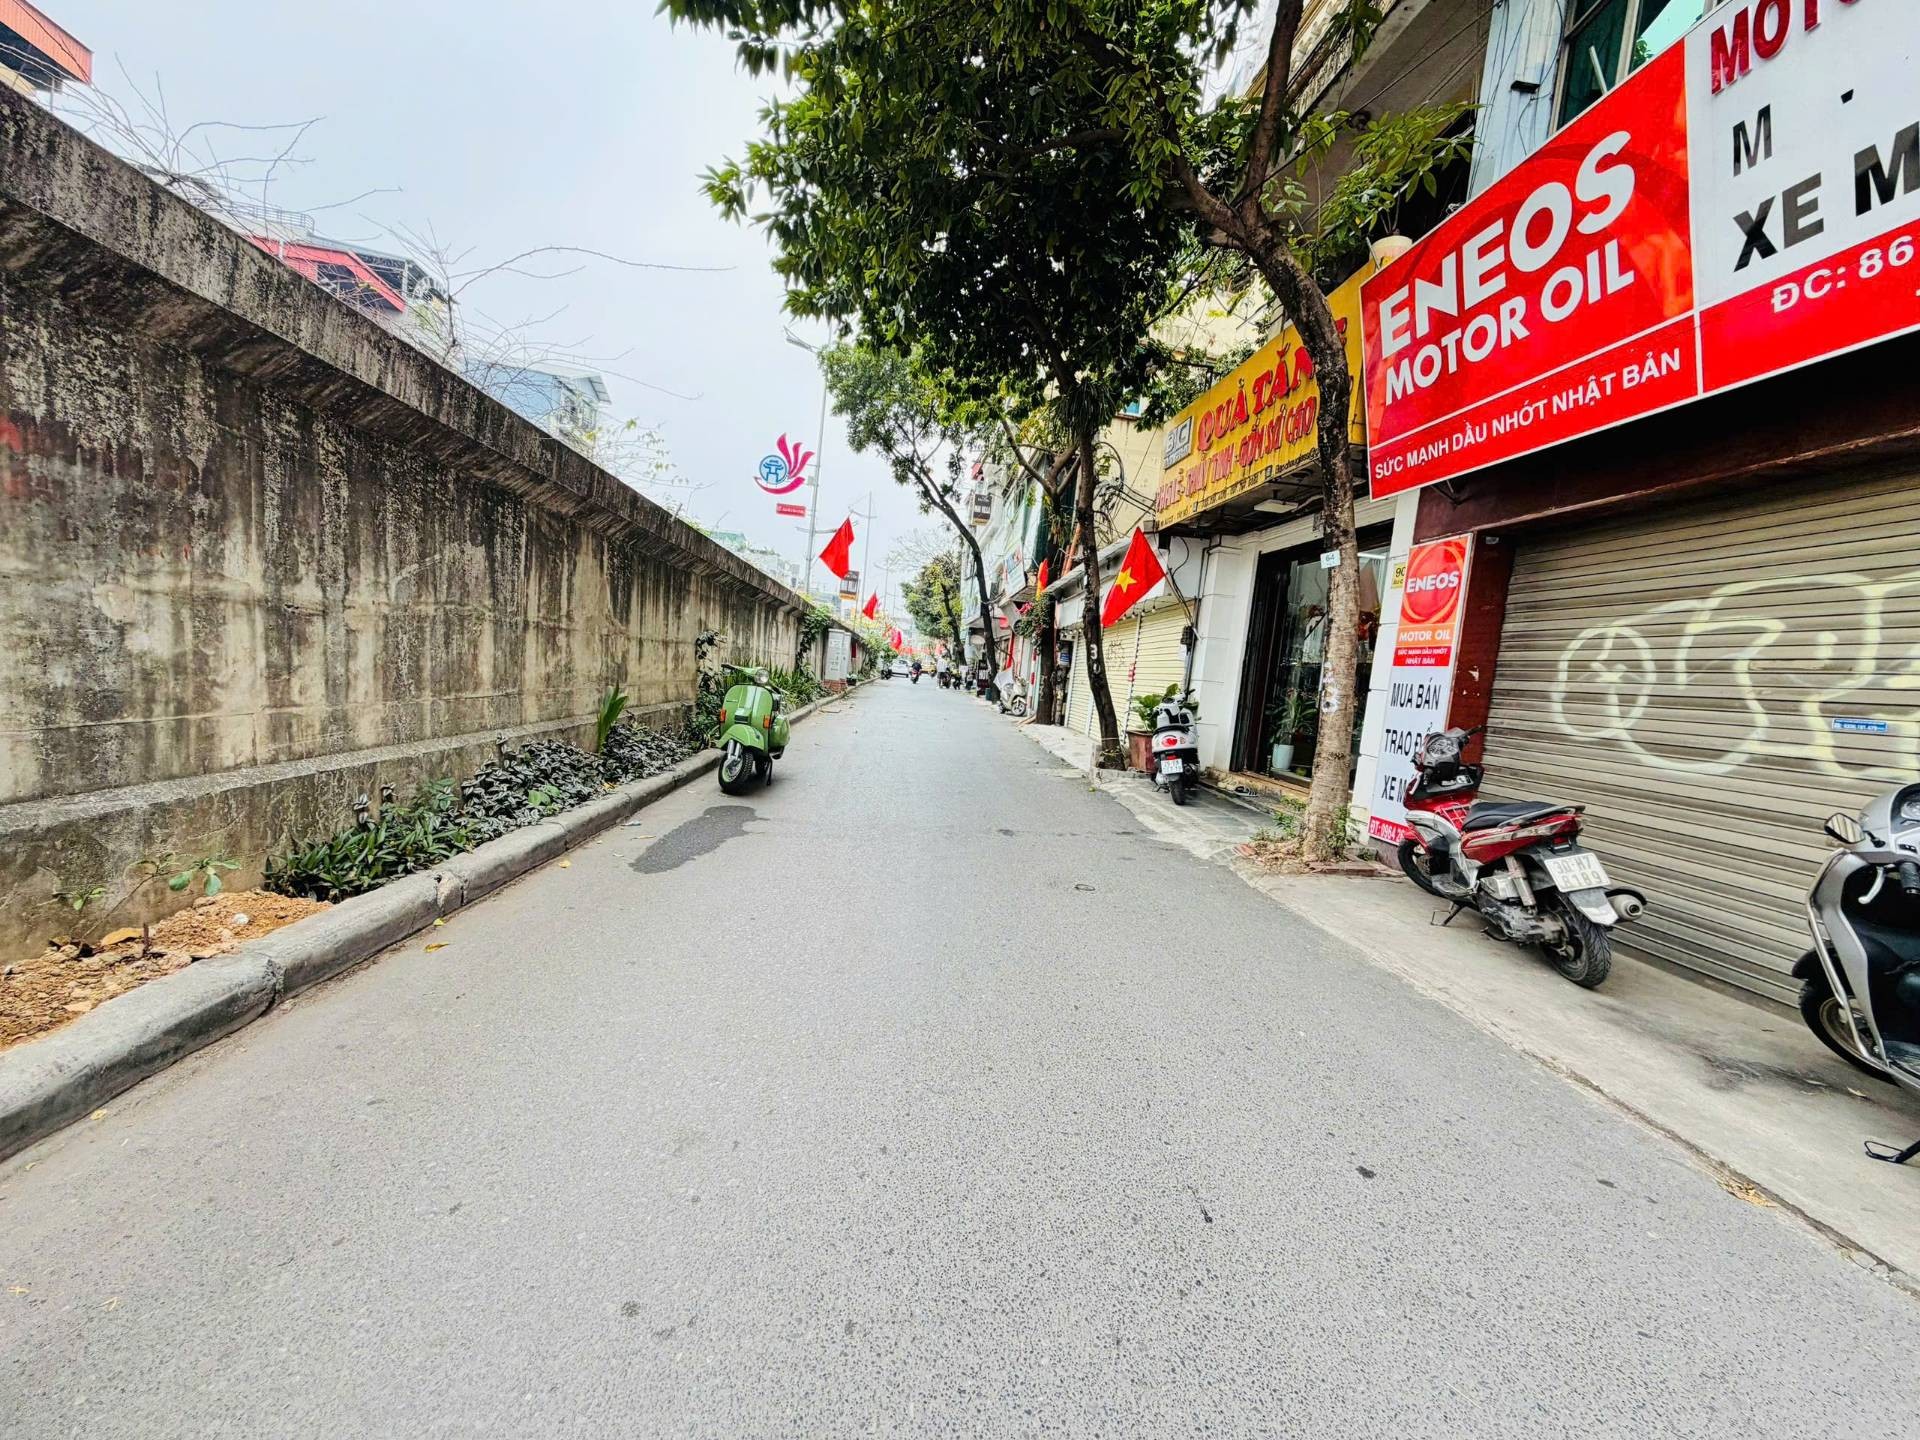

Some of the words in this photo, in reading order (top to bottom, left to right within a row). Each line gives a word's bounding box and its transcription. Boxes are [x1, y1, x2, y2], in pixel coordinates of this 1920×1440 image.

[1711, 0, 1862, 95] MO
[1379, 130, 1637, 358] ENEOS
[1733, 172, 1824, 272] XE
[1771, 266, 1846, 313] ĐC:
[1385, 296, 1530, 406] MOTOR
[1541, 240, 1635, 323] OIL
[1375, 455, 1404, 480] SỨC
[1406, 438, 1450, 468] MẠNH
[1452, 422, 1488, 452] DẦU
[1492, 398, 1549, 437] NHỚT
[1552, 373, 1617, 416] NHẬT
[1622, 348, 1682, 390] BẢN
[1406, 571, 1460, 594] ENEOS
[1398, 630, 1433, 642] MOTOR
[1434, 629, 1451, 641] OIL
[1390, 682, 1413, 708] MUA
[1416, 677, 1441, 710] BÁN
[1385, 728, 1412, 756] TRAO
[1382, 774, 1396, 801] XE
